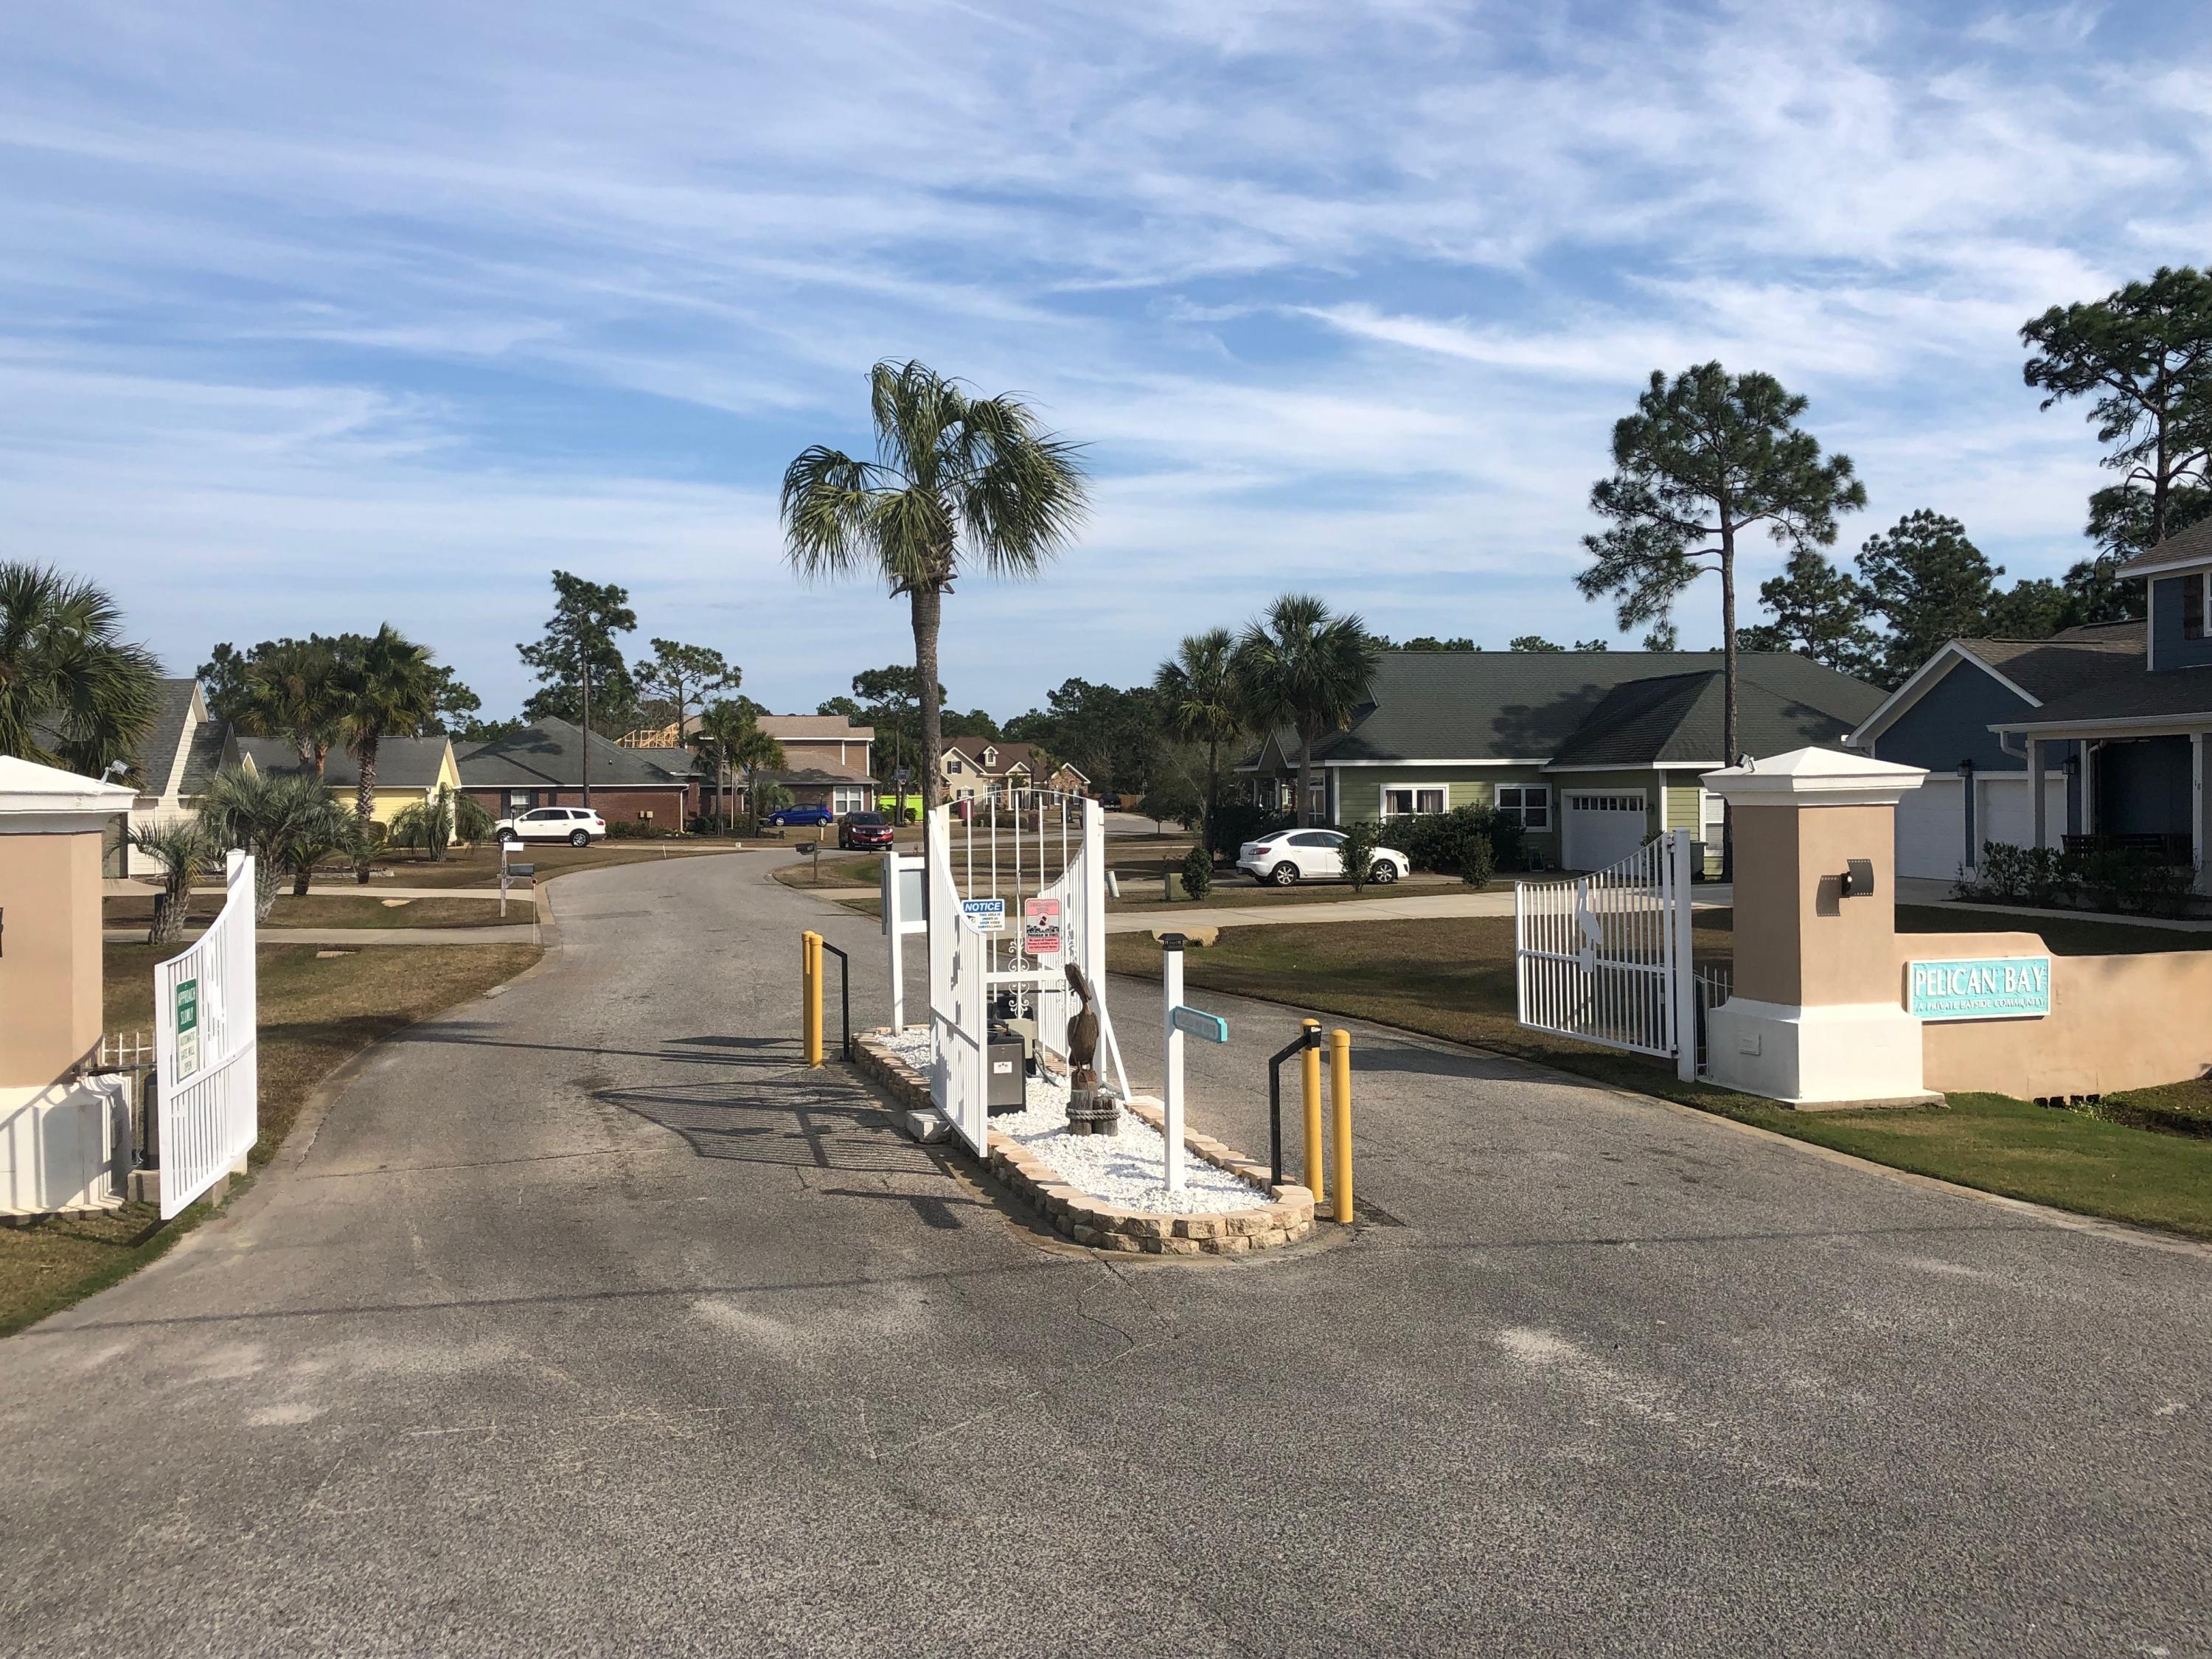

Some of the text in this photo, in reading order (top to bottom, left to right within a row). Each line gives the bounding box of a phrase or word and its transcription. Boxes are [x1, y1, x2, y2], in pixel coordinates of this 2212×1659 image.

[965, 902, 1001, 911] NOTICE
[1915, 966, 2044, 996] PELICAN BAY
[178, 987, 195, 1006] APPROACH
[1916, 997, 2045, 1012] A PRIVATE BAYSIDE COMMUNITY
[181, 1007, 193, 1025] SLOWLY
